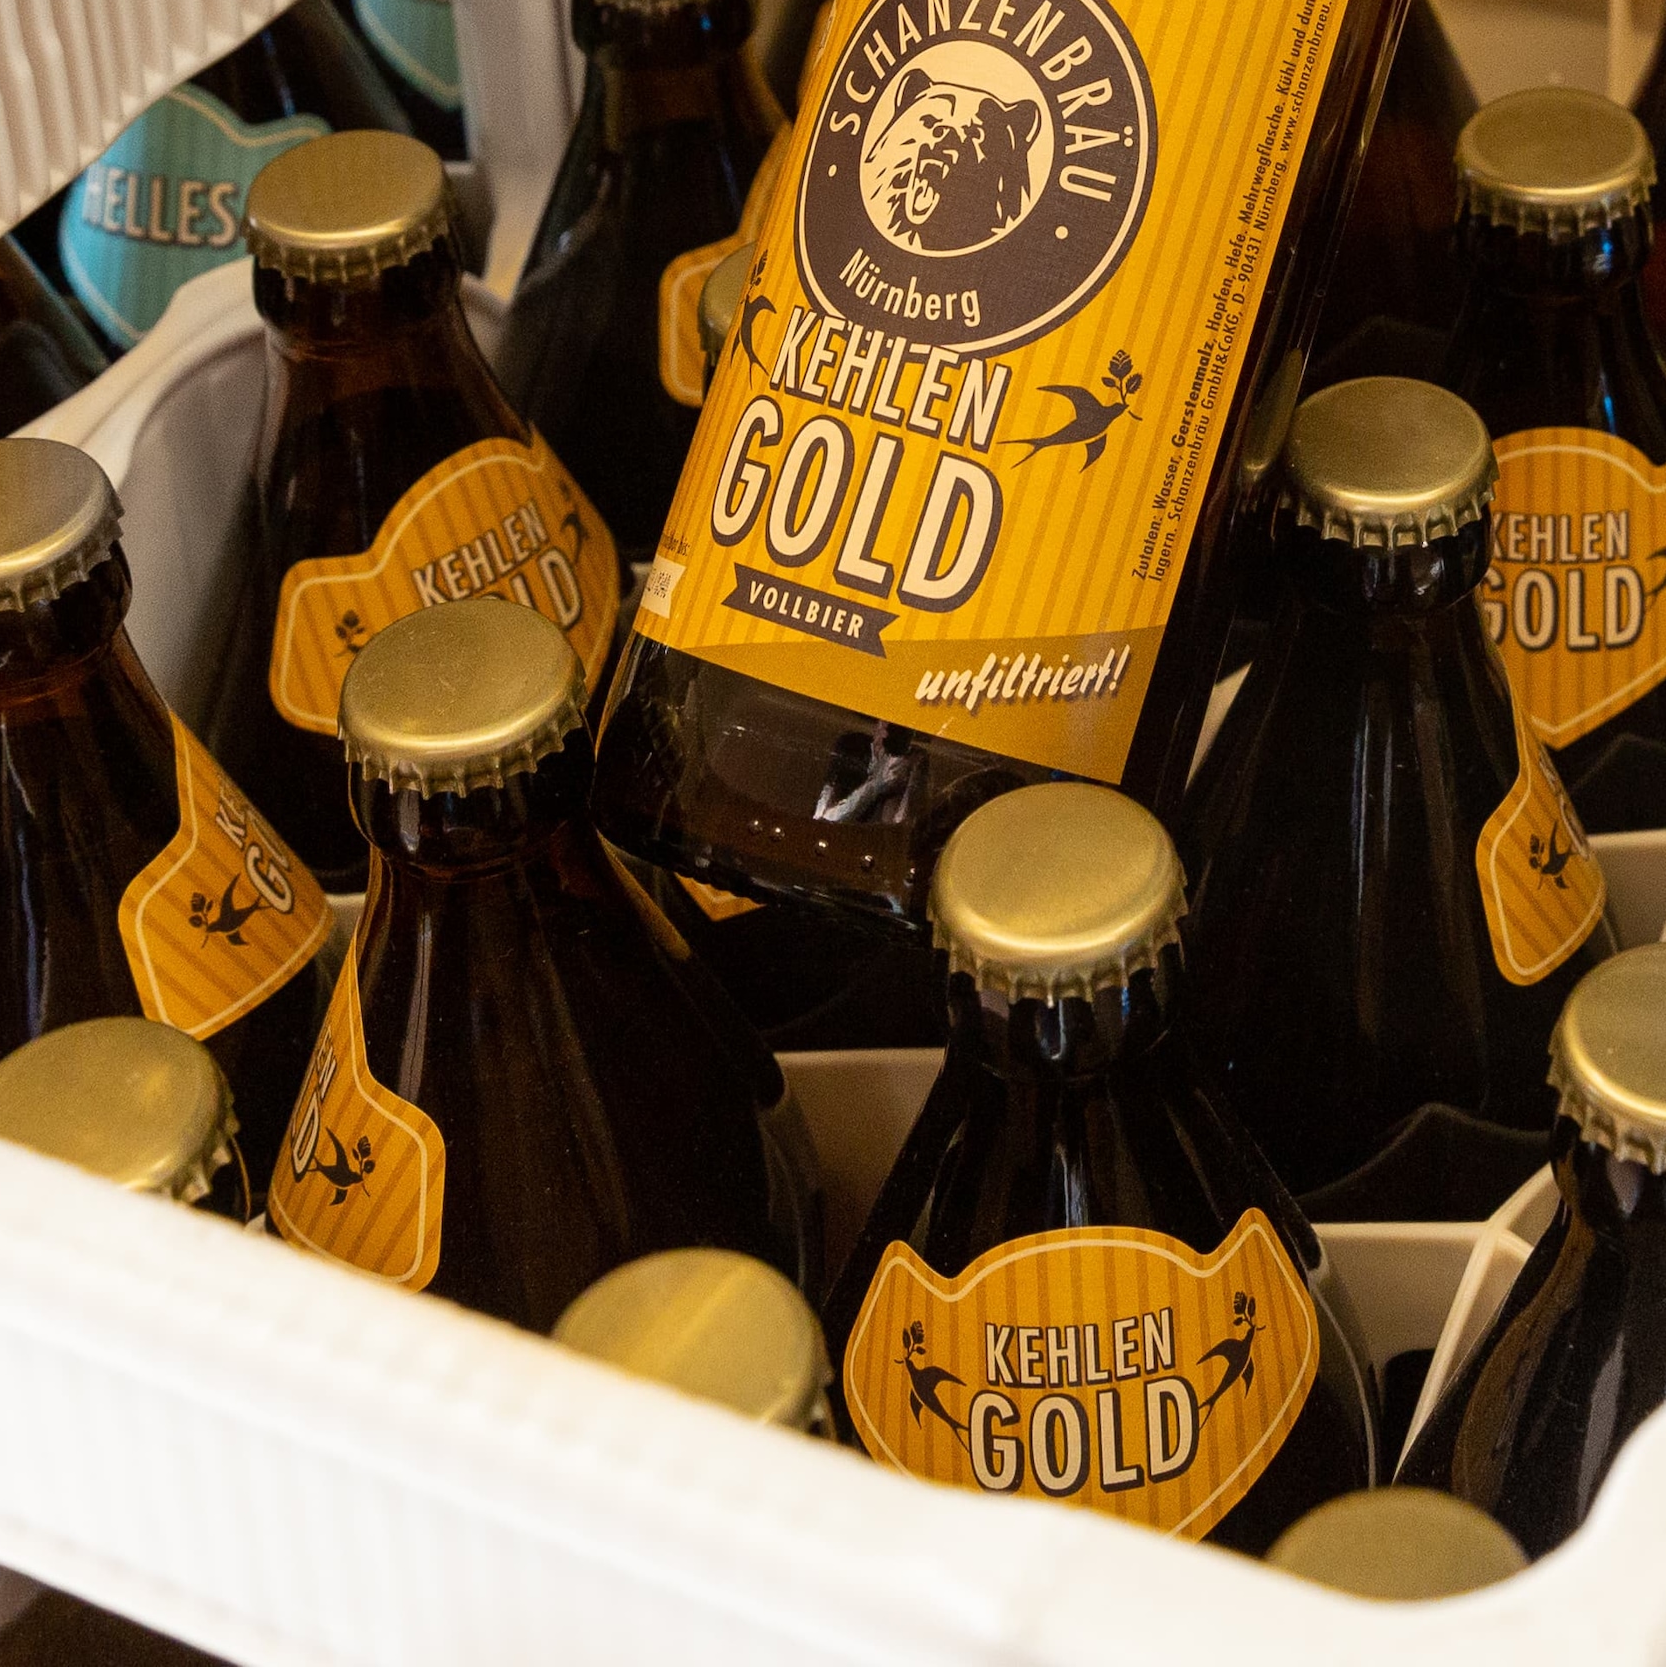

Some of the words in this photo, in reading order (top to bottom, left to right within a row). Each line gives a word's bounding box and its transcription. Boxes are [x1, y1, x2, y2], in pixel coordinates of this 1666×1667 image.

[839, 248, 982, 328] Nürnberg
[1131, 515, 1163, 580] Zutaten:
[1152, 455, 1183, 511] Wasser,
[1171, 338, 1218, 448] Gerstenmalz,
[1205, 275, 1237, 332] Hopfen,
[1224, 230, 1248, 268] Hefe.
[1237, 101, 1286, 225] Mehrwegflasche.
[1276, 60, 1297, 96] Kühl
[1291, 27, 1307, 58] und
[769, 306, 1012, 454] KEHLEN
[1148, 528, 1178, 582] lagern.
[1168, 414, 1210, 522] Schanzenbräu
[1253, 158, 1288, 232] Nürnberg,
[411, 500, 550, 608] KEHLEN
[711, 395, 1004, 614] GOLD
[747, 580, 866, 639] VOLLBIER
[913, 645, 1132, 714] unfiltriert!
[984, 1307, 1175, 1388] KEHLEN
[967, 1376, 1202, 1498] GOLD
